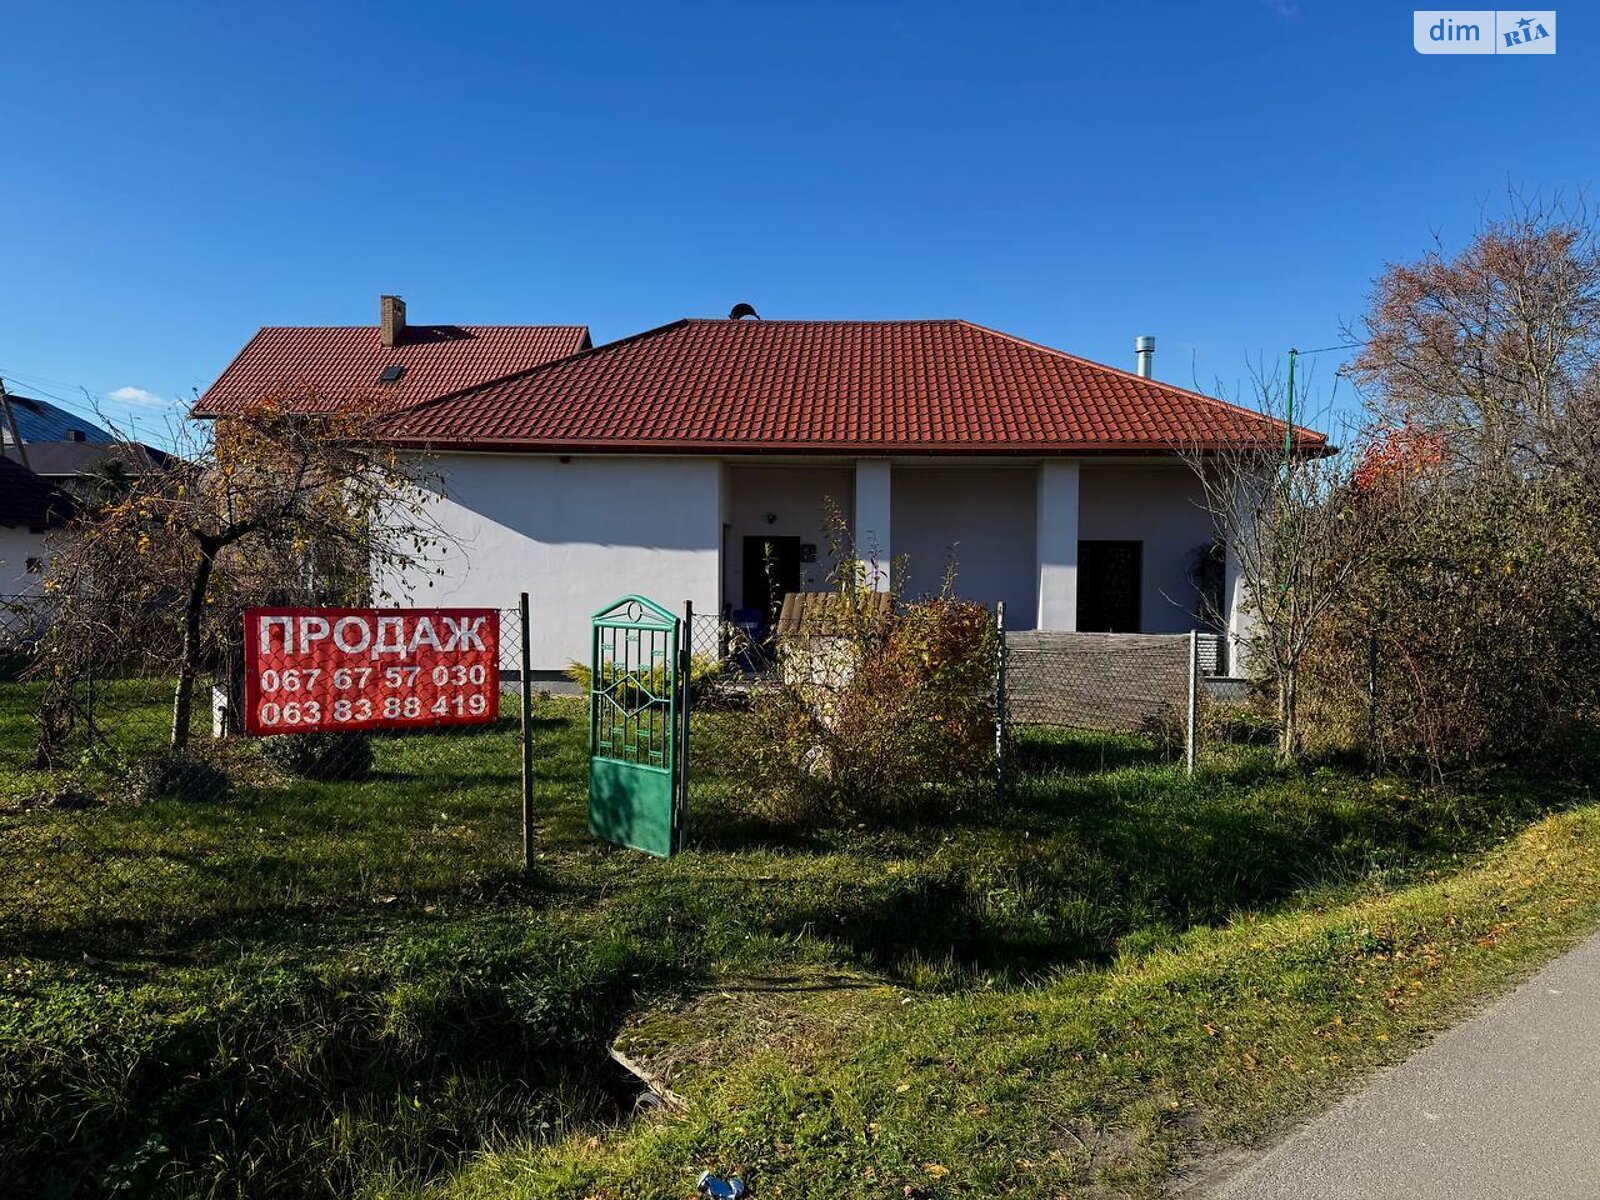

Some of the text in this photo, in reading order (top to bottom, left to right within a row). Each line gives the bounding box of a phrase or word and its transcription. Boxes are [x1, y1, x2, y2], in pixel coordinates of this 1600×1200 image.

[259, 615, 487, 661] ПРОДАЖ
[260, 664, 486, 693] 067 67 57 030
[260, 694, 487, 726] 063 83 88 419
